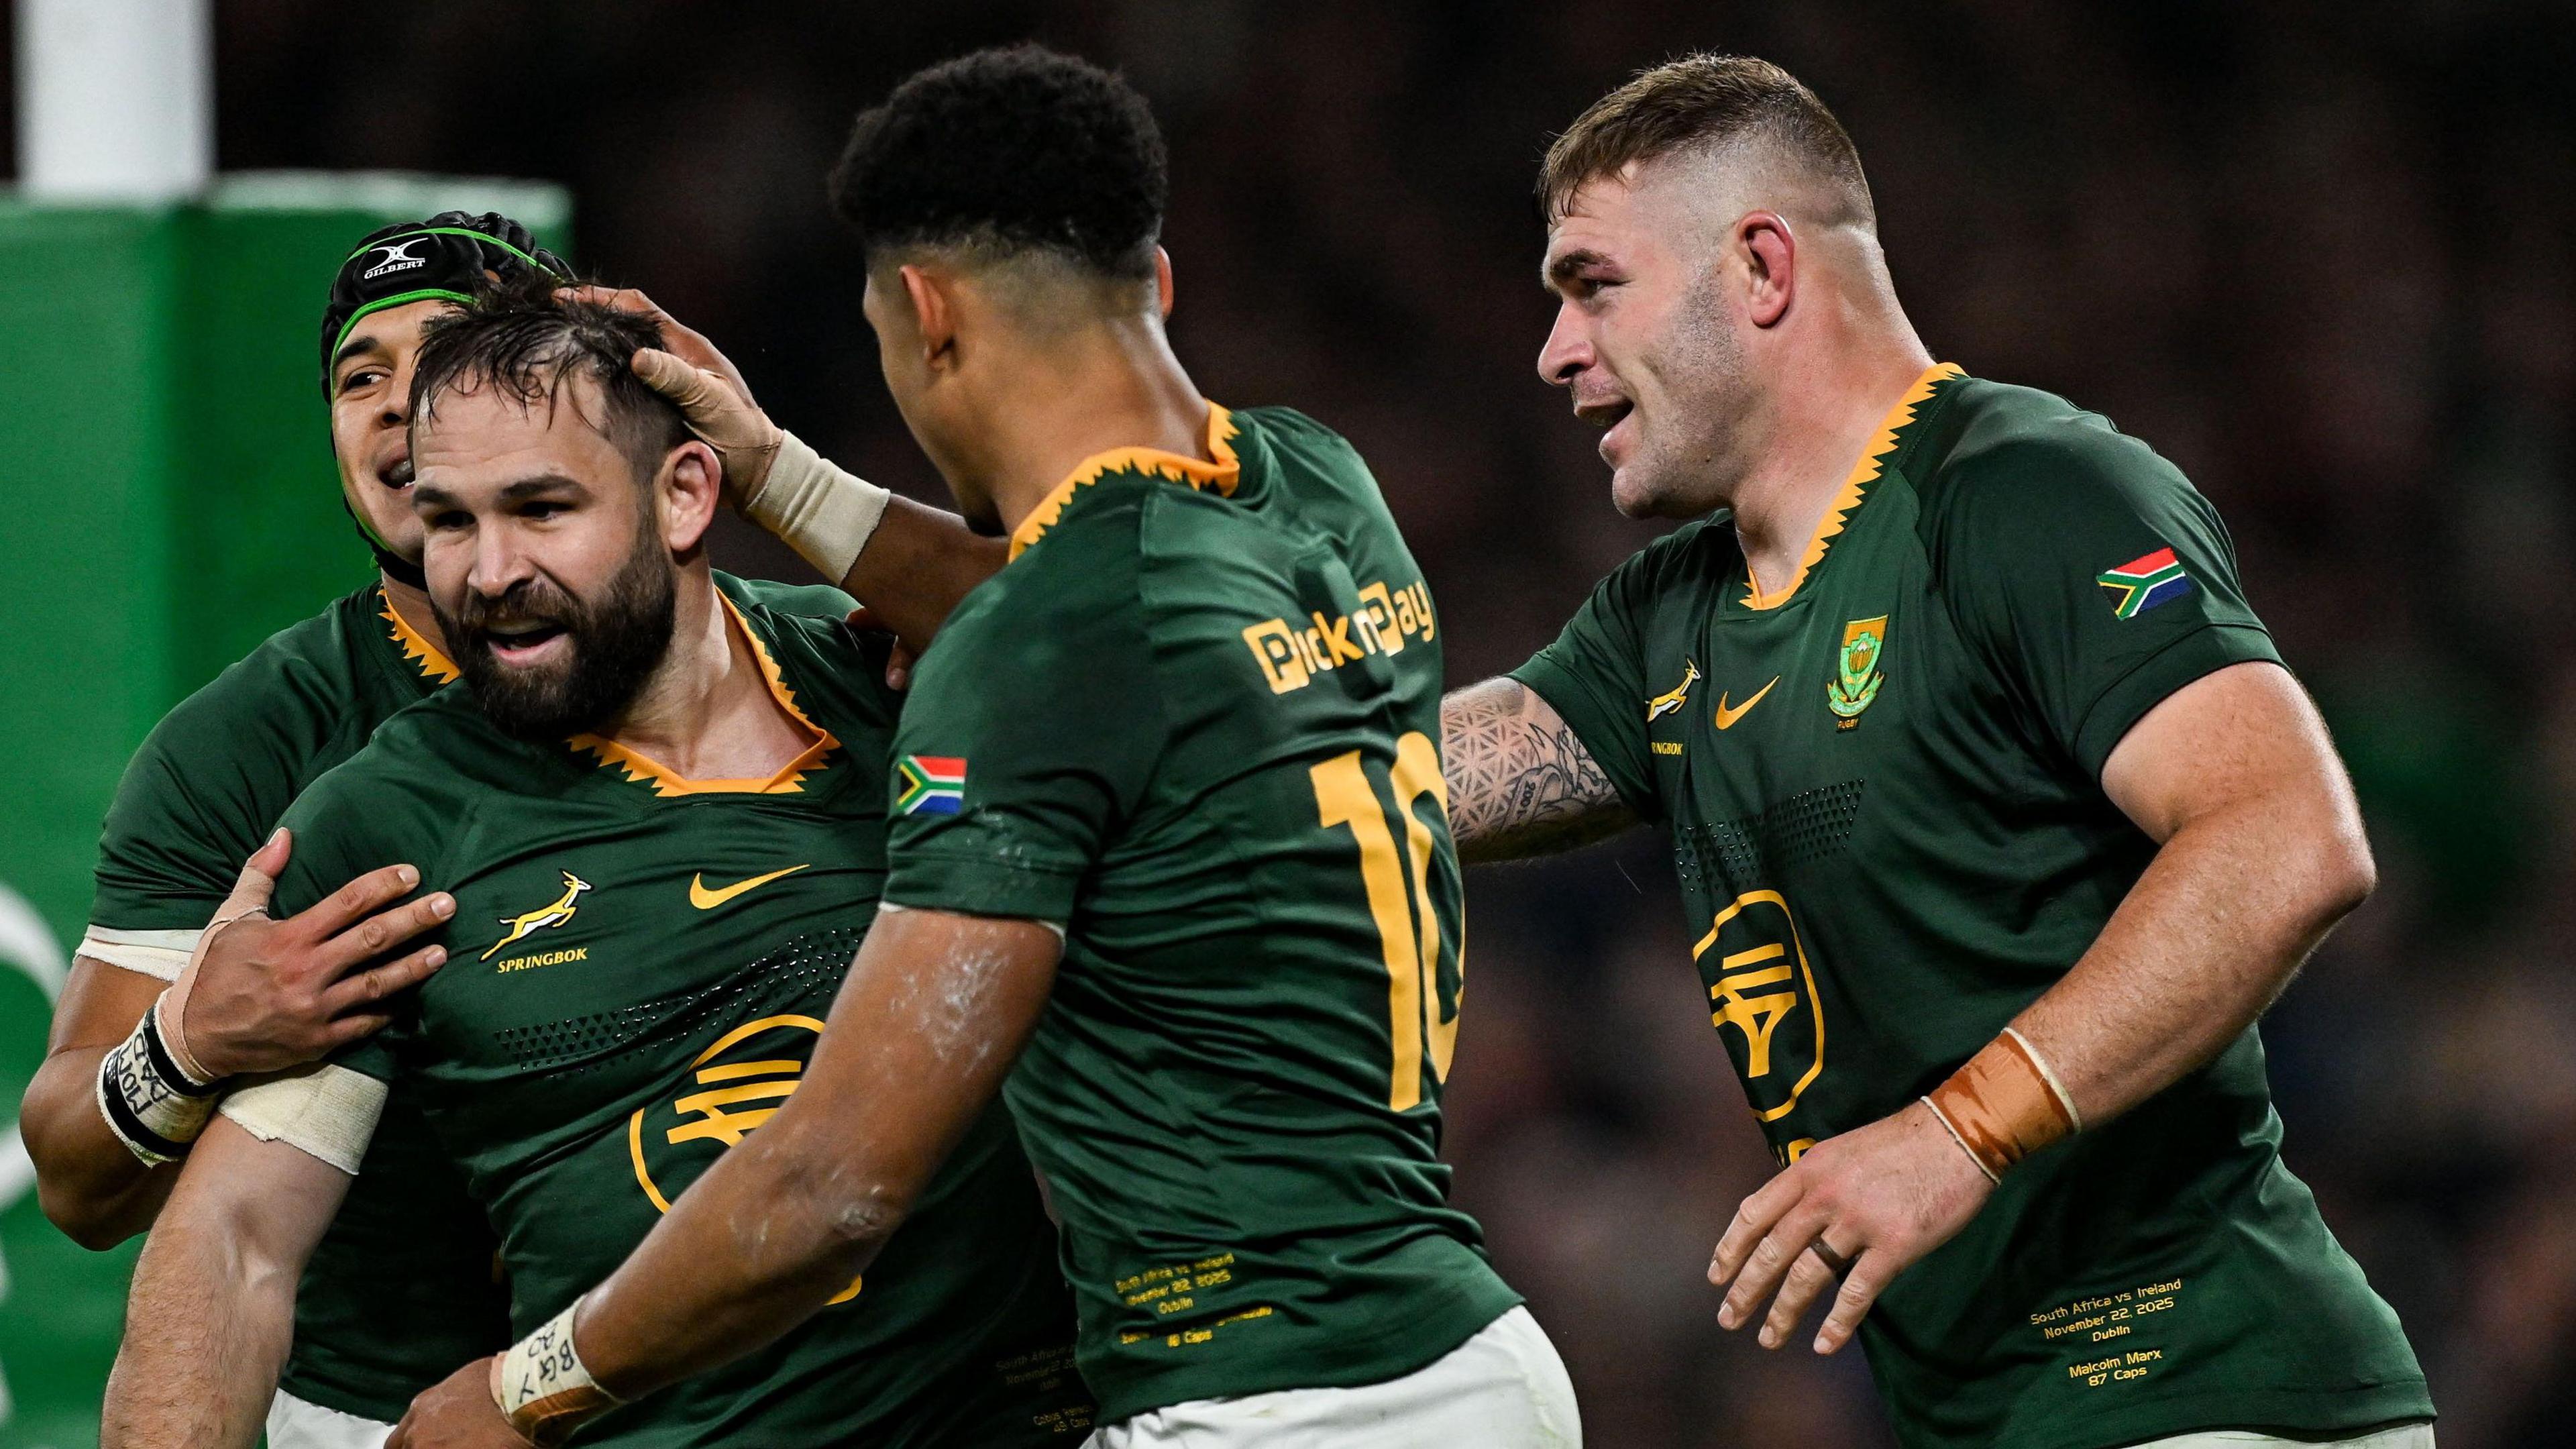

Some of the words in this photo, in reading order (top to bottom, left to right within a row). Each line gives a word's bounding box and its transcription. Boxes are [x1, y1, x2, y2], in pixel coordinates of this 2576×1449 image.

[364, 259, 425, 279] GILBERT
[1242, 610, 1364, 695] Pick
[1837, 718, 1859, 729] RUGBY
[1309, 731, 1465, 1114] 10
[497, 947, 588, 973] SPRINGBOK
[2030, 1306, 2069, 1326] South
[2072, 1297, 2112, 1316] Africa
[2115, 1292, 2132, 1303] vs
[2137, 1278, 2182, 1299] Ireland
[2044, 1316, 2106, 1340] November
[2109, 1307, 2133, 1322] 22,
[2135, 1297, 2175, 1316] 2025
[2092, 1325, 2131, 1342] Dublin
[2069, 1357, 2121, 1378] Malcolm
[2126, 1349, 2163, 1365] Marx
[2088, 1373, 2108, 1387] 87
[2113, 1366, 2148, 1381] Caps
